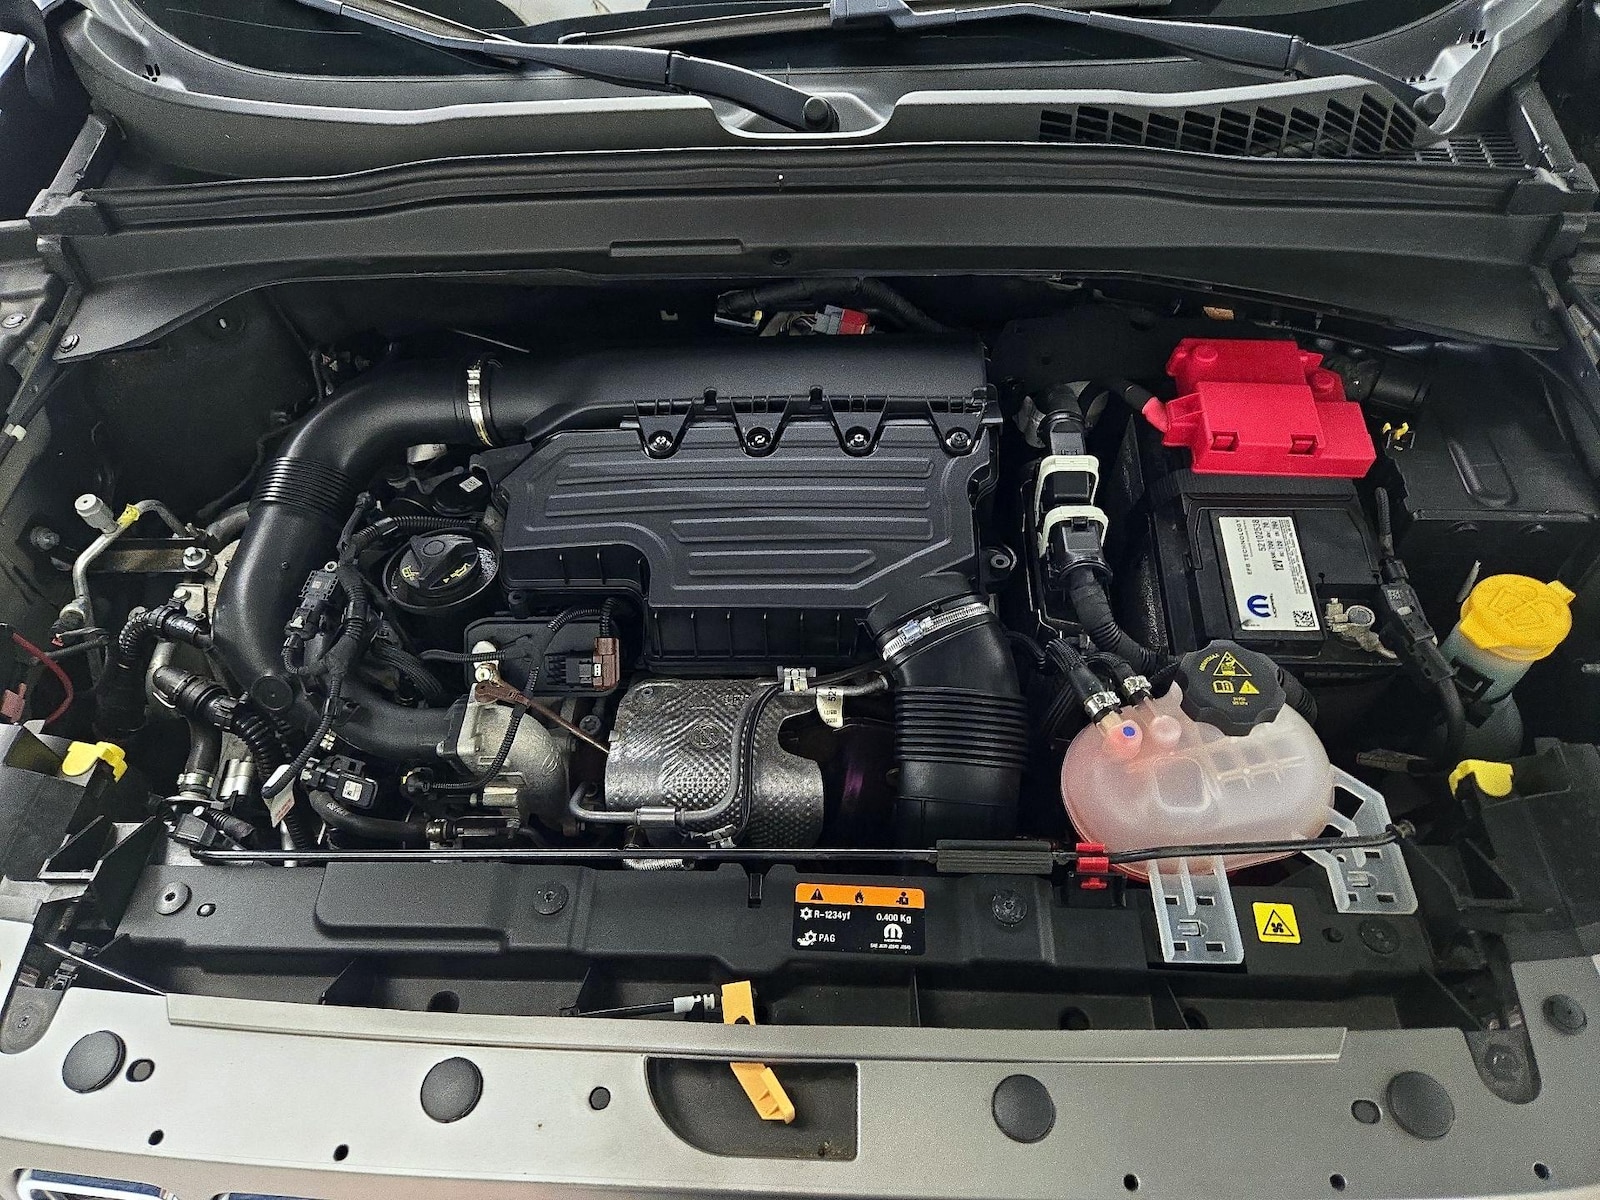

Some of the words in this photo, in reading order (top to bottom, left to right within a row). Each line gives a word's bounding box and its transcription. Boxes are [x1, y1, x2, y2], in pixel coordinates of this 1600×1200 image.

[1236, 519, 1249, 561] TECHNOLOGY
[1251, 519, 1266, 551] 52102538
[1245, 563, 1253, 575] EFB
[1272, 560, 1284, 571] 12V
[814, 910, 850, 921] R-1234yf
[876, 913, 898, 921] 0.400
[900, 914, 911, 924] Kg
